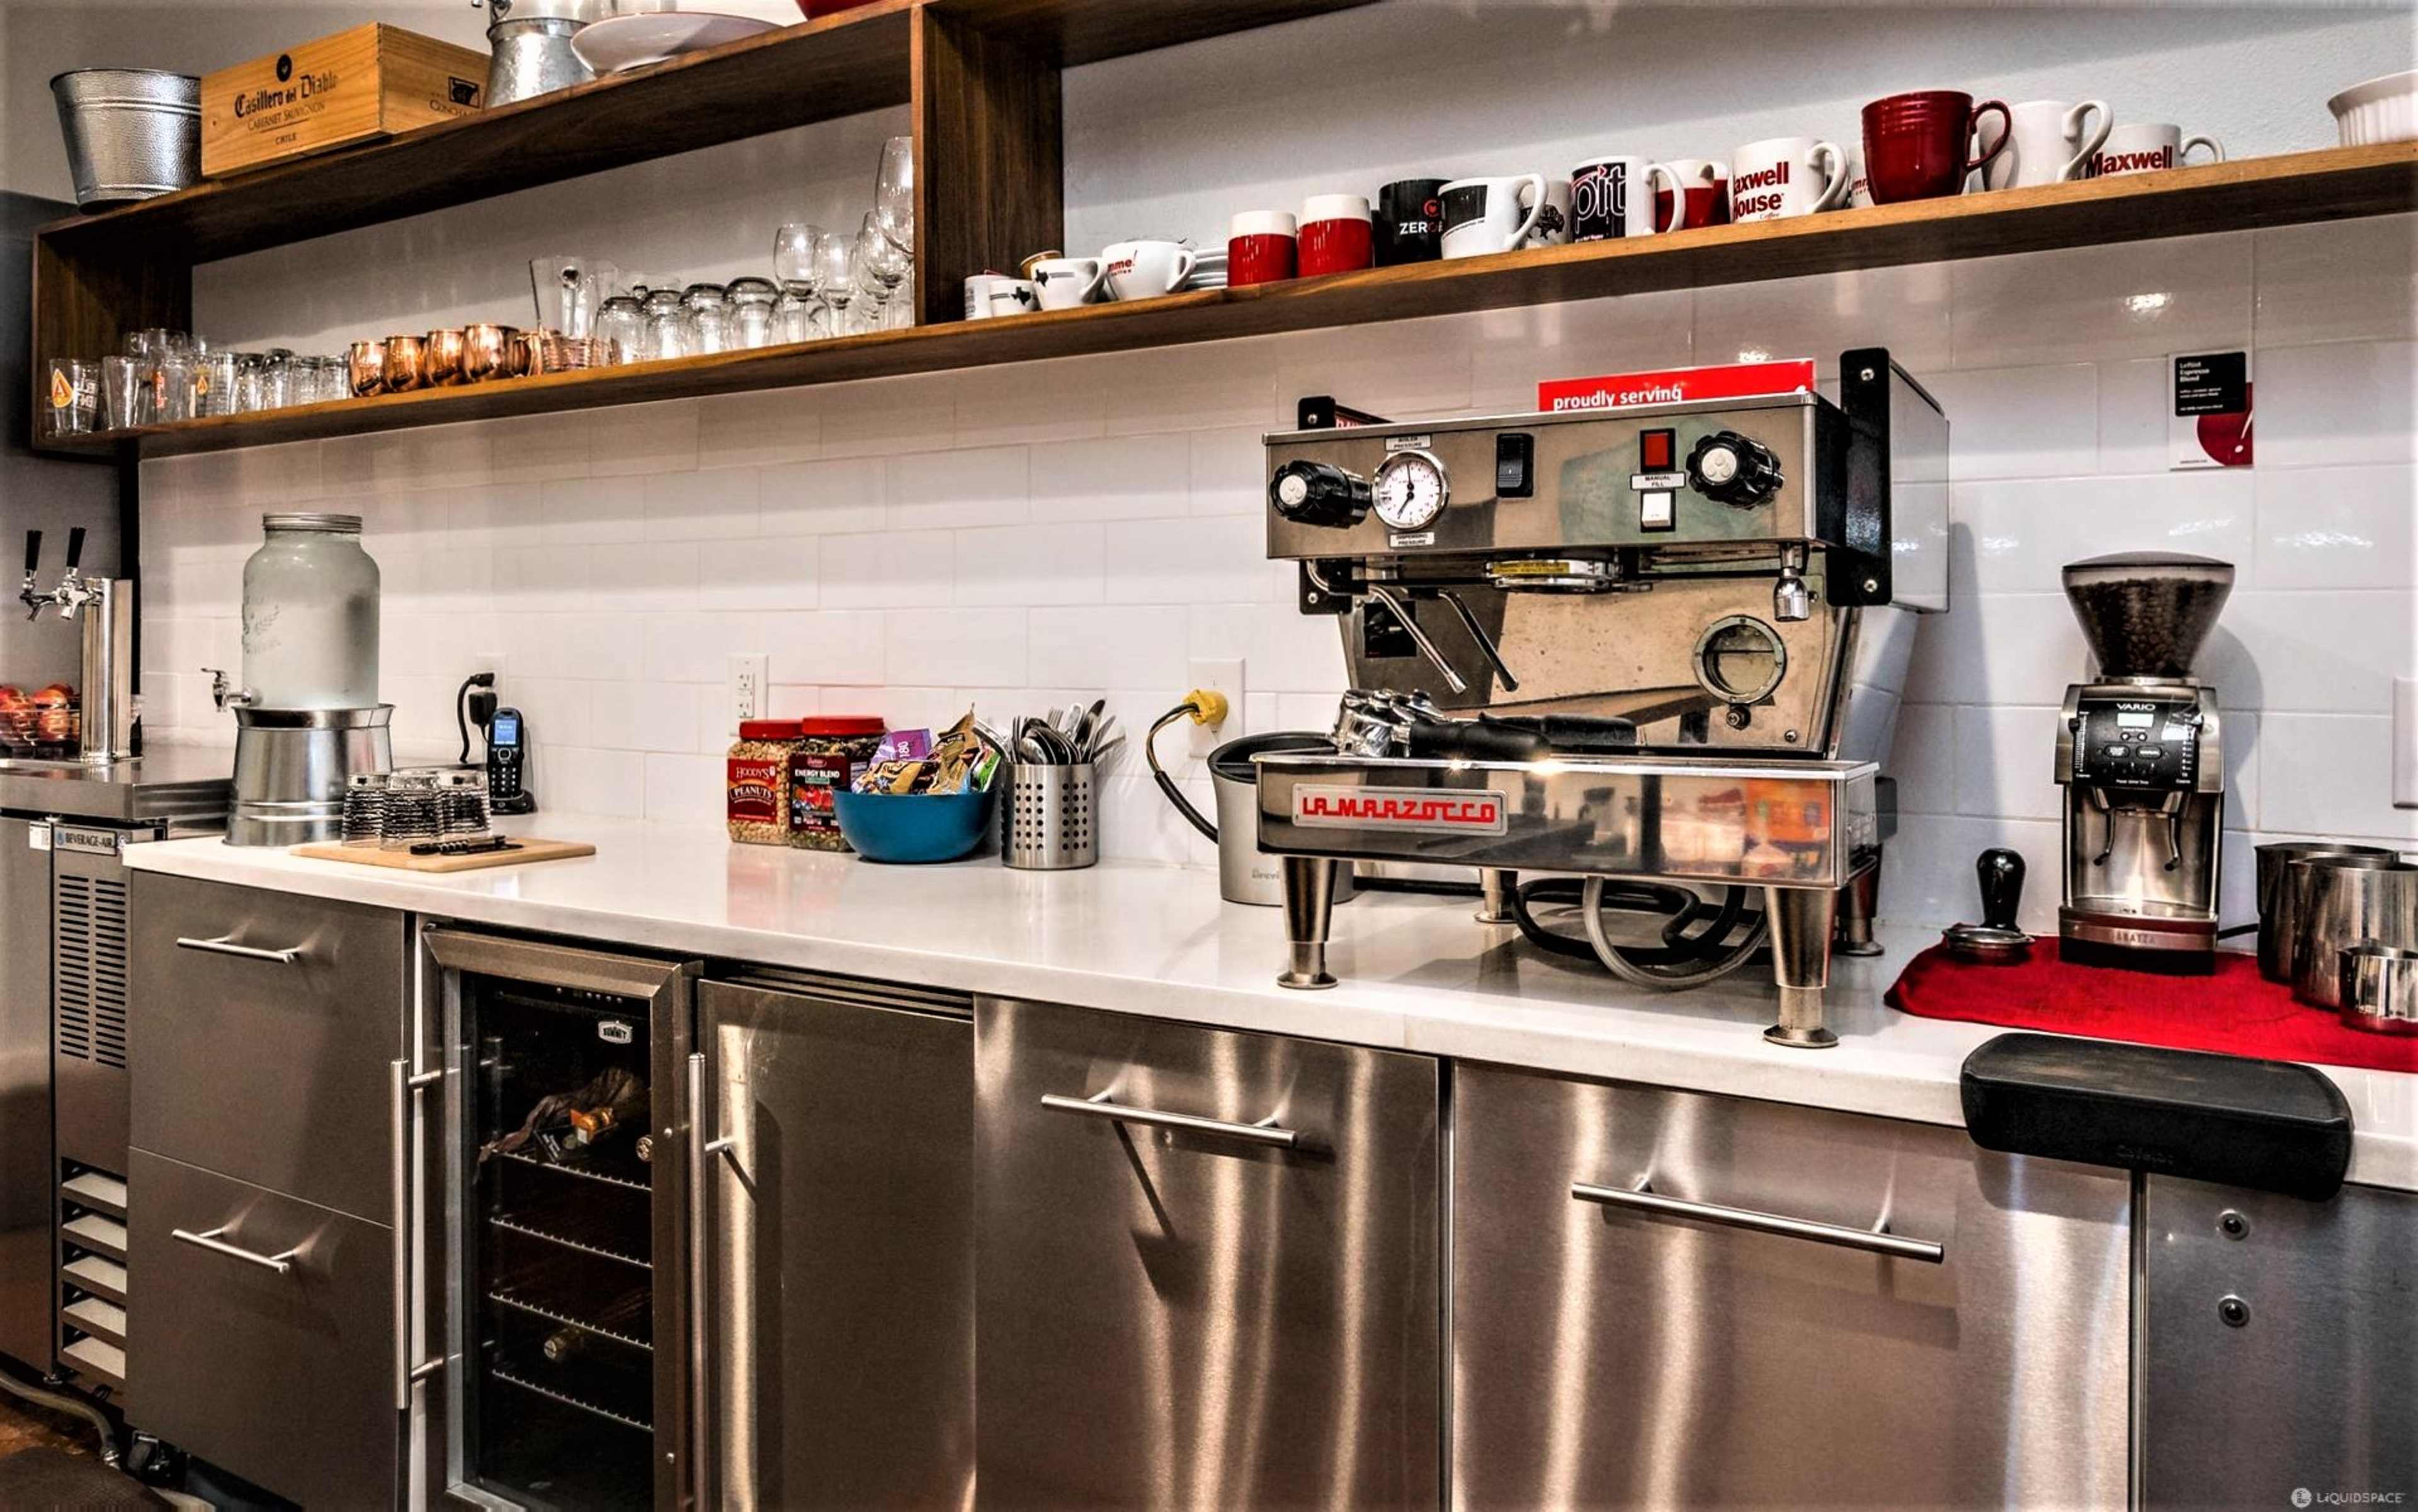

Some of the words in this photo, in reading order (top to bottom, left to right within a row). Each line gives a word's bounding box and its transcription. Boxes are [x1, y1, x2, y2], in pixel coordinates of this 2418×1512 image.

[235, 91, 283, 118] Casillero
[285, 87, 297, 105] del
[247, 111, 282, 131] CABERNET
[283, 101, 325, 122] SAUVIGNON
[275, 132, 297, 145] CHILE
[2085, 145, 2173, 179] Maxwell
[1734, 161, 1790, 196] axwell
[1553, 389, 1615, 413] proudly
[1619, 383, 1683, 405] serving
[2116, 702, 2156, 712] VARIO
[735, 766, 769, 780] HOODY'S
[794, 768, 819, 777] ENERGY
[819, 769, 841, 779] BLEND
[734, 785, 773, 799] PEANUTS
[1303, 797, 1327, 815] LA
[65, 832, 113, 849] BEVERAGE-AIR
